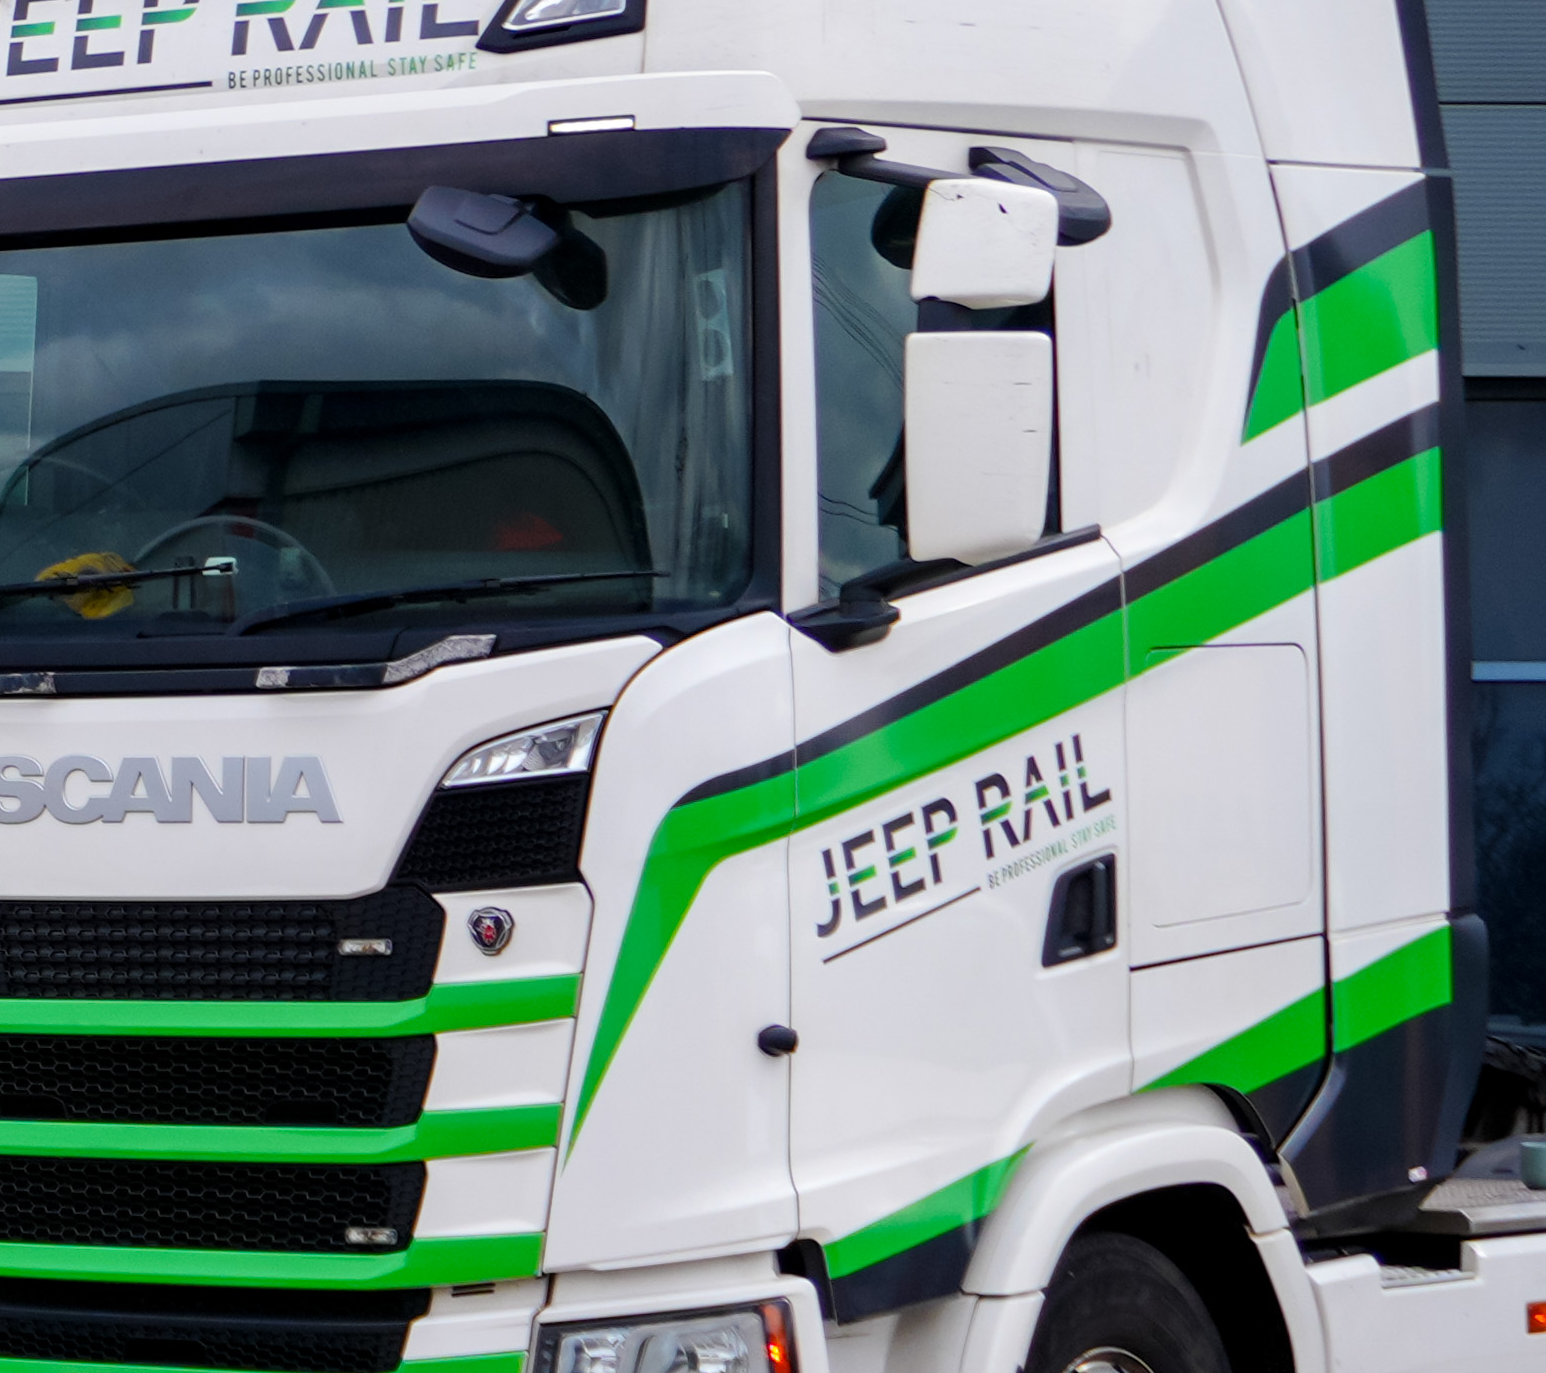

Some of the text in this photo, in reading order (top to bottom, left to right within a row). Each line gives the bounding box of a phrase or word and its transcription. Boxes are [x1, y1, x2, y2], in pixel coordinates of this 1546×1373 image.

[227, 51, 479, 90] BE PROFESSIONAL STAY SAFE
[815, 733, 1112, 938] JEEP RAIL
[1001, 838, 1069, 883] PROFESSIONAL
